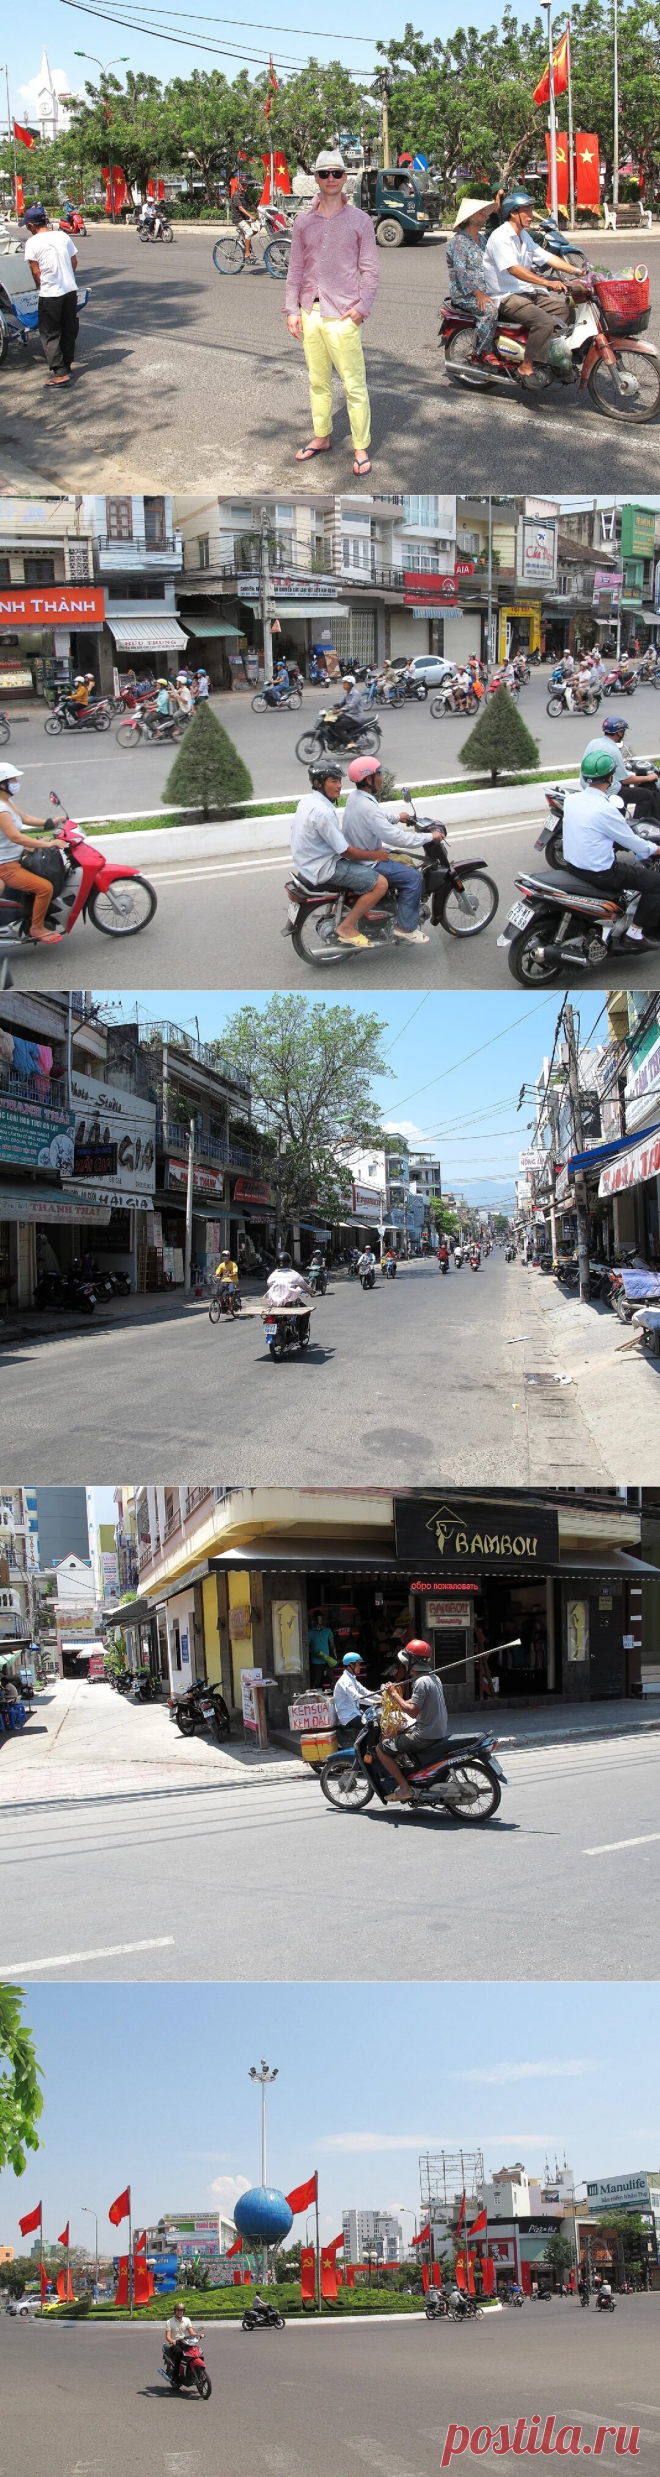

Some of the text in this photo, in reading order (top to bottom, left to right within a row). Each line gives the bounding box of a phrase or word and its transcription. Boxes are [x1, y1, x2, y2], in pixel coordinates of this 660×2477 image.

[456, 565, 470, 574] AIA
[30, 597, 96, 613] THÀNH
[118, 1134, 154, 1171] GIA
[99, 1191, 123, 1206] HẢI
[126, 1198, 149, 1209] GIA
[30, 1203, 73, 1214] THANH
[75, 1205, 100, 1216] THÁI
[455, 1532, 539, 1556] BAMBOU
[429, 1603, 469, 1614] BAMBOU
[293, 1717, 310, 1729] KEM
[600, 2178, 646, 2195] Manulife
[528, 2224, 558, 2233] Pizza Hut
